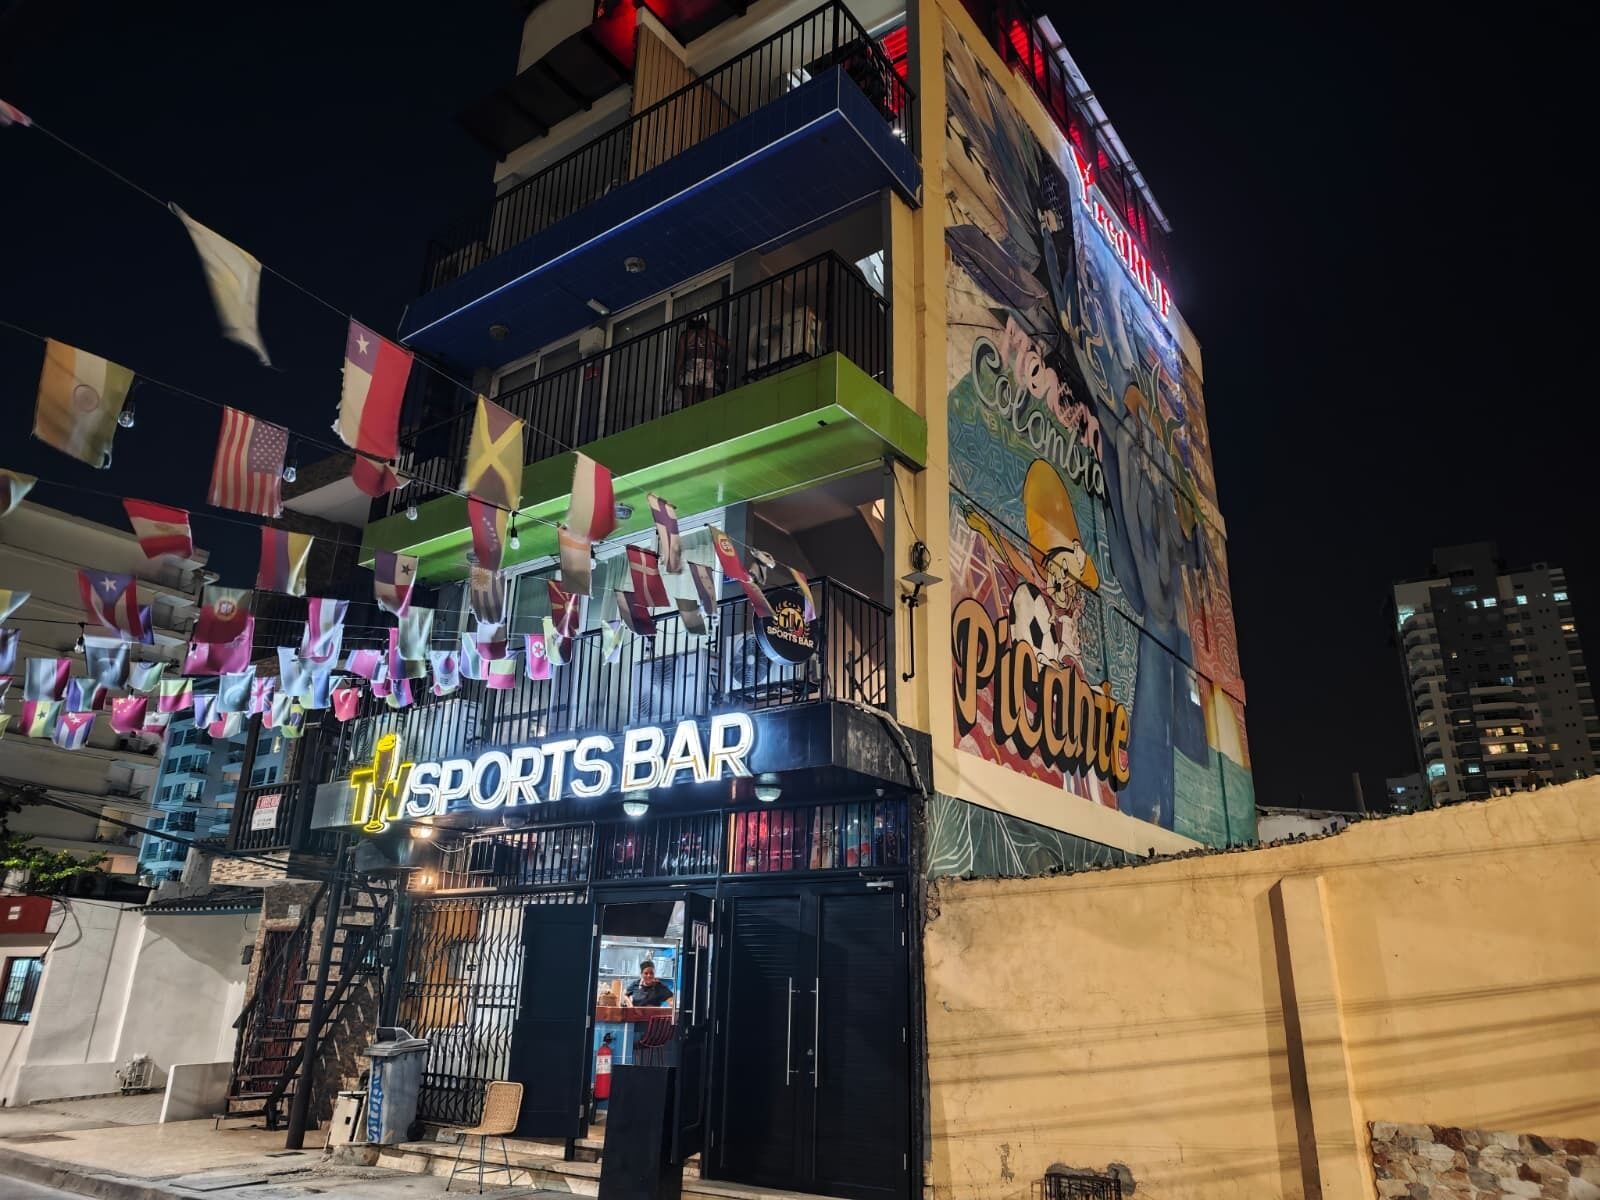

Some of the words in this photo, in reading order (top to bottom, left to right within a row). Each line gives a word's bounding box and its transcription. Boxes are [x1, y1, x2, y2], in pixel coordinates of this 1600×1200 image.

[972, 335, 1106, 500] Colombia
[767, 626, 798, 644] SPORTS
[798, 636, 814, 648] BAR
[952, 597, 1131, 791] Picante
[407, 736, 614, 816] SPORTS
[620, 712, 754, 792] BAR
